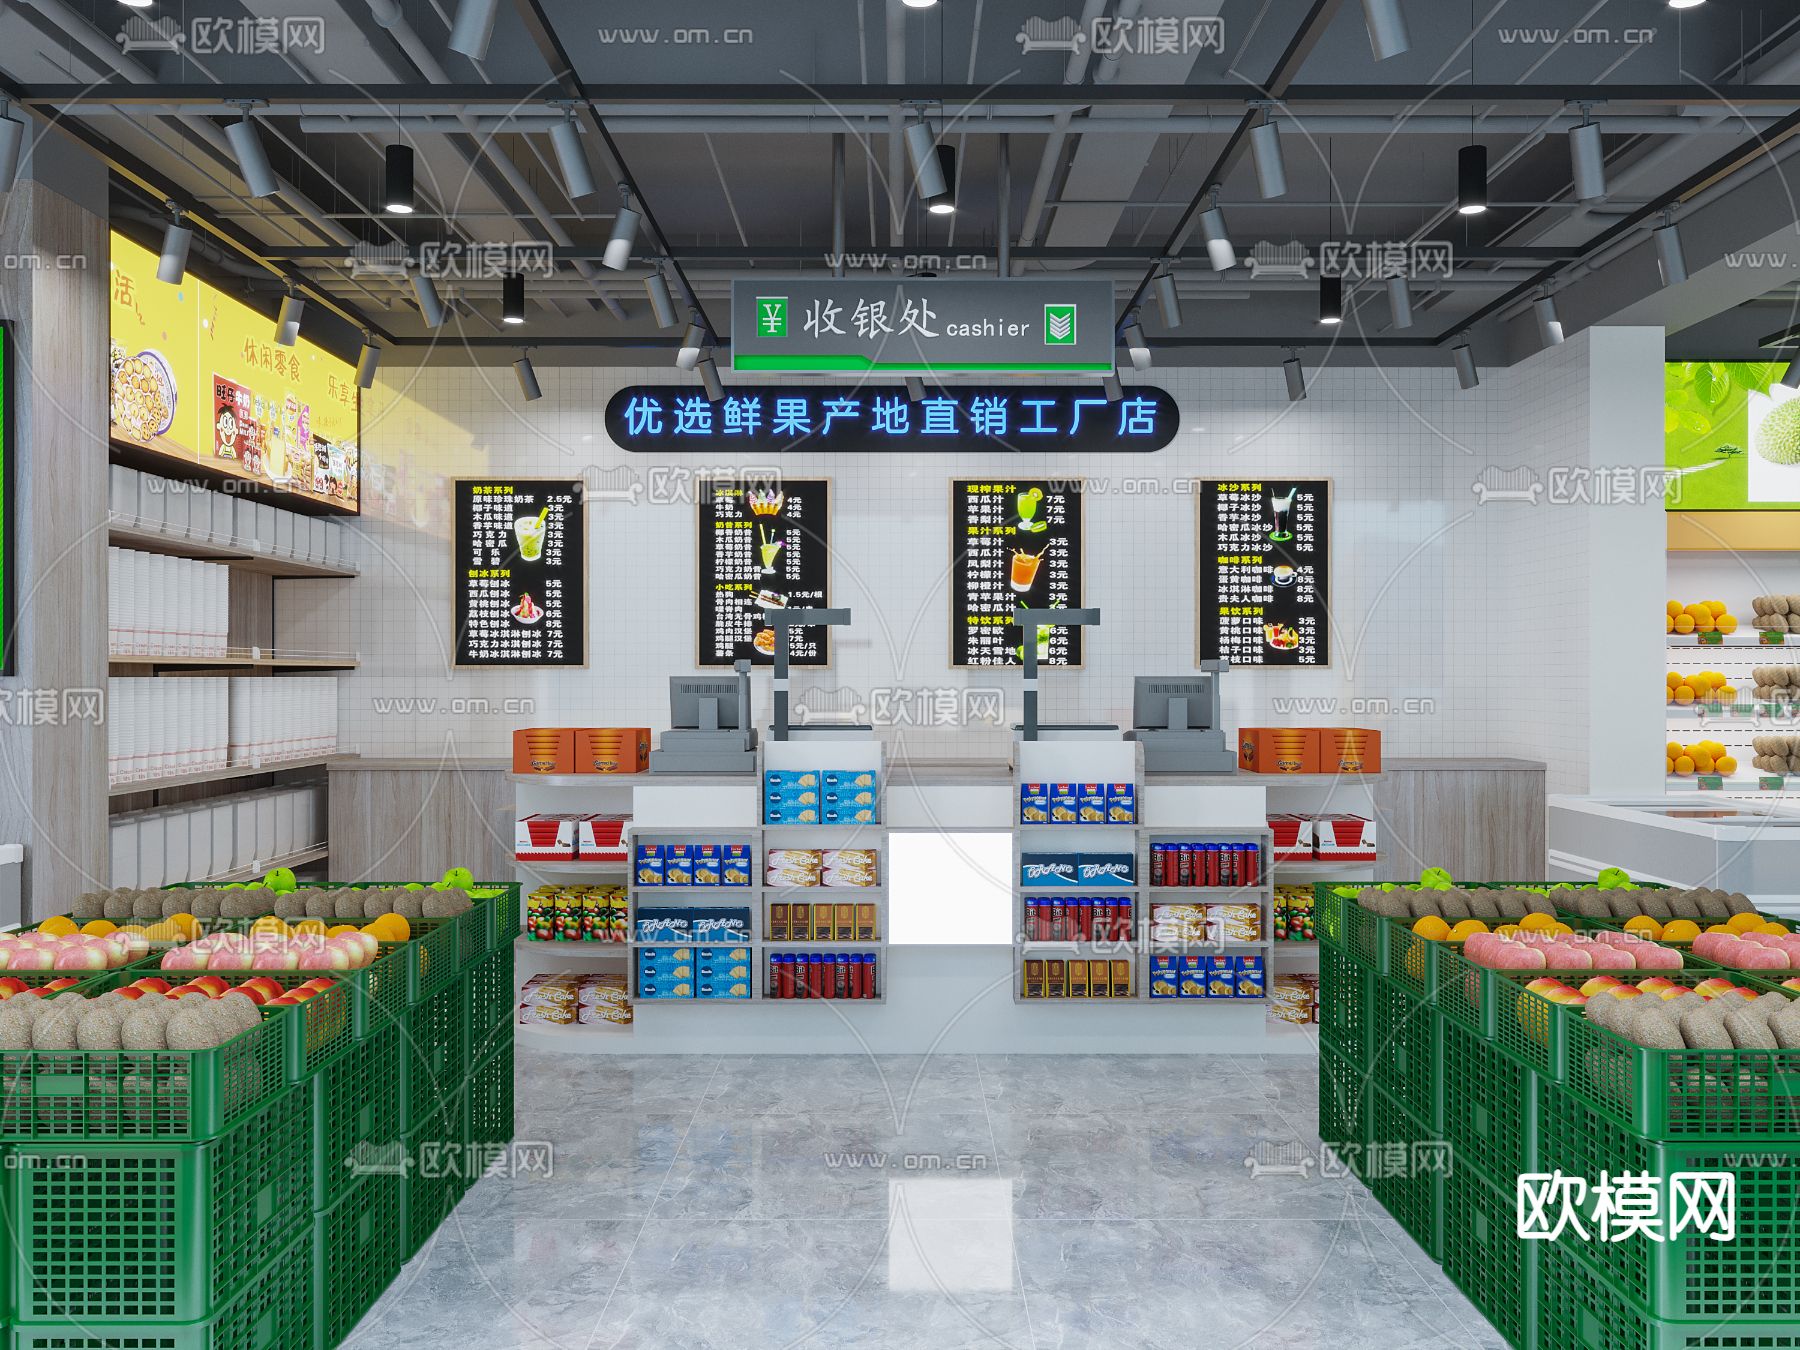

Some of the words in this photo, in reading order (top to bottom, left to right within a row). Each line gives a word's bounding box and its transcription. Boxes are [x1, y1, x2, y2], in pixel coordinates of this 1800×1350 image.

[802, 297, 940, 341] 收银处
[946, 317, 1031, 338] cashier
[243, 337, 301, 382] 休闲零食
[624, 395, 1159, 437] 优选鲜果产地直销工厂店
[472, 486, 513, 494] 奶茶系列
[967, 485, 1016, 493] 现榨果汁
[1217, 483, 1262, 492] 冰沙系列
[967, 496, 1004, 504] 西瓜汁
[1046, 496, 1065, 504] 7元
[1217, 494, 1261, 502] 草莓冰沙
[967, 506, 1004, 514] 苹果汁
[1046, 506, 1065, 514] 7元
[472, 513, 513, 521] 木瓜味道
[967, 516, 1004, 524] 香梨汁
[1046, 516, 1065, 524] 7元
[715, 521, 752, 529] 奶昔系列
[1217, 524, 1273, 532] 哈密瓜冰沙
[472, 531, 507, 539] 巧克力
[547, 531, 563, 539] 3元
[967, 527, 1017, 535] 果汁系列
[967, 538, 1004, 546] 草莓汁
[1049, 538, 1068, 546] 3元
[1217, 534, 1261, 542] 木瓜冰沙
[1296, 534, 1314, 542] 5元
[1217, 544, 1273, 552] 巧克力冰沙
[967, 549, 1004, 557] 西瓜汁
[1049, 549, 1068, 557] 3元
[1049, 560, 1068, 568] 3元
[468, 570, 510, 578] 刨冰系列
[1297, 566, 1314, 574] 4元
[1049, 571, 1068, 579] 3元
[468, 580, 510, 588] 草莓刨冰
[545, 580, 562, 588] 5元
[715, 583, 752, 591] 小吃系列
[1049, 582, 1068, 590] 3元
[1297, 585, 1314, 593] 8元
[468, 590, 510, 598] 西瓜刨冰
[545, 590, 562, 598] 5元
[967, 593, 1016, 601] 青苹果汁
[1048, 593, 1068, 601] 3元
[1297, 595, 1314, 603] 8元
[468, 600, 510, 608] 黄桃刨冰
[1219, 607, 1264, 615] 果饮系列
[468, 620, 510, 628] 特色刨冰
[1298, 617, 1315, 625] 3元
[967, 627, 1004, 635] 罗密欧
[1049, 627, 1068, 635] 6元
[1298, 627, 1315, 635] 3元
[1049, 637, 1068, 645] 6元
[1298, 636, 1315, 644] 3元
[967, 647, 1016, 655] 冰天雪地
[1048, 647, 1068, 655] 6元
[1298, 646, 1315, 654] 3元
[967, 657, 1016, 665] 红粉佳人
[1048, 657, 1068, 665] 8元
[1298, 656, 1315, 664] 5元
[552, 990, 575, 1002] Cake
[551, 1008, 572, 1020] Cake
[610, 1008, 632, 1020] Cake
